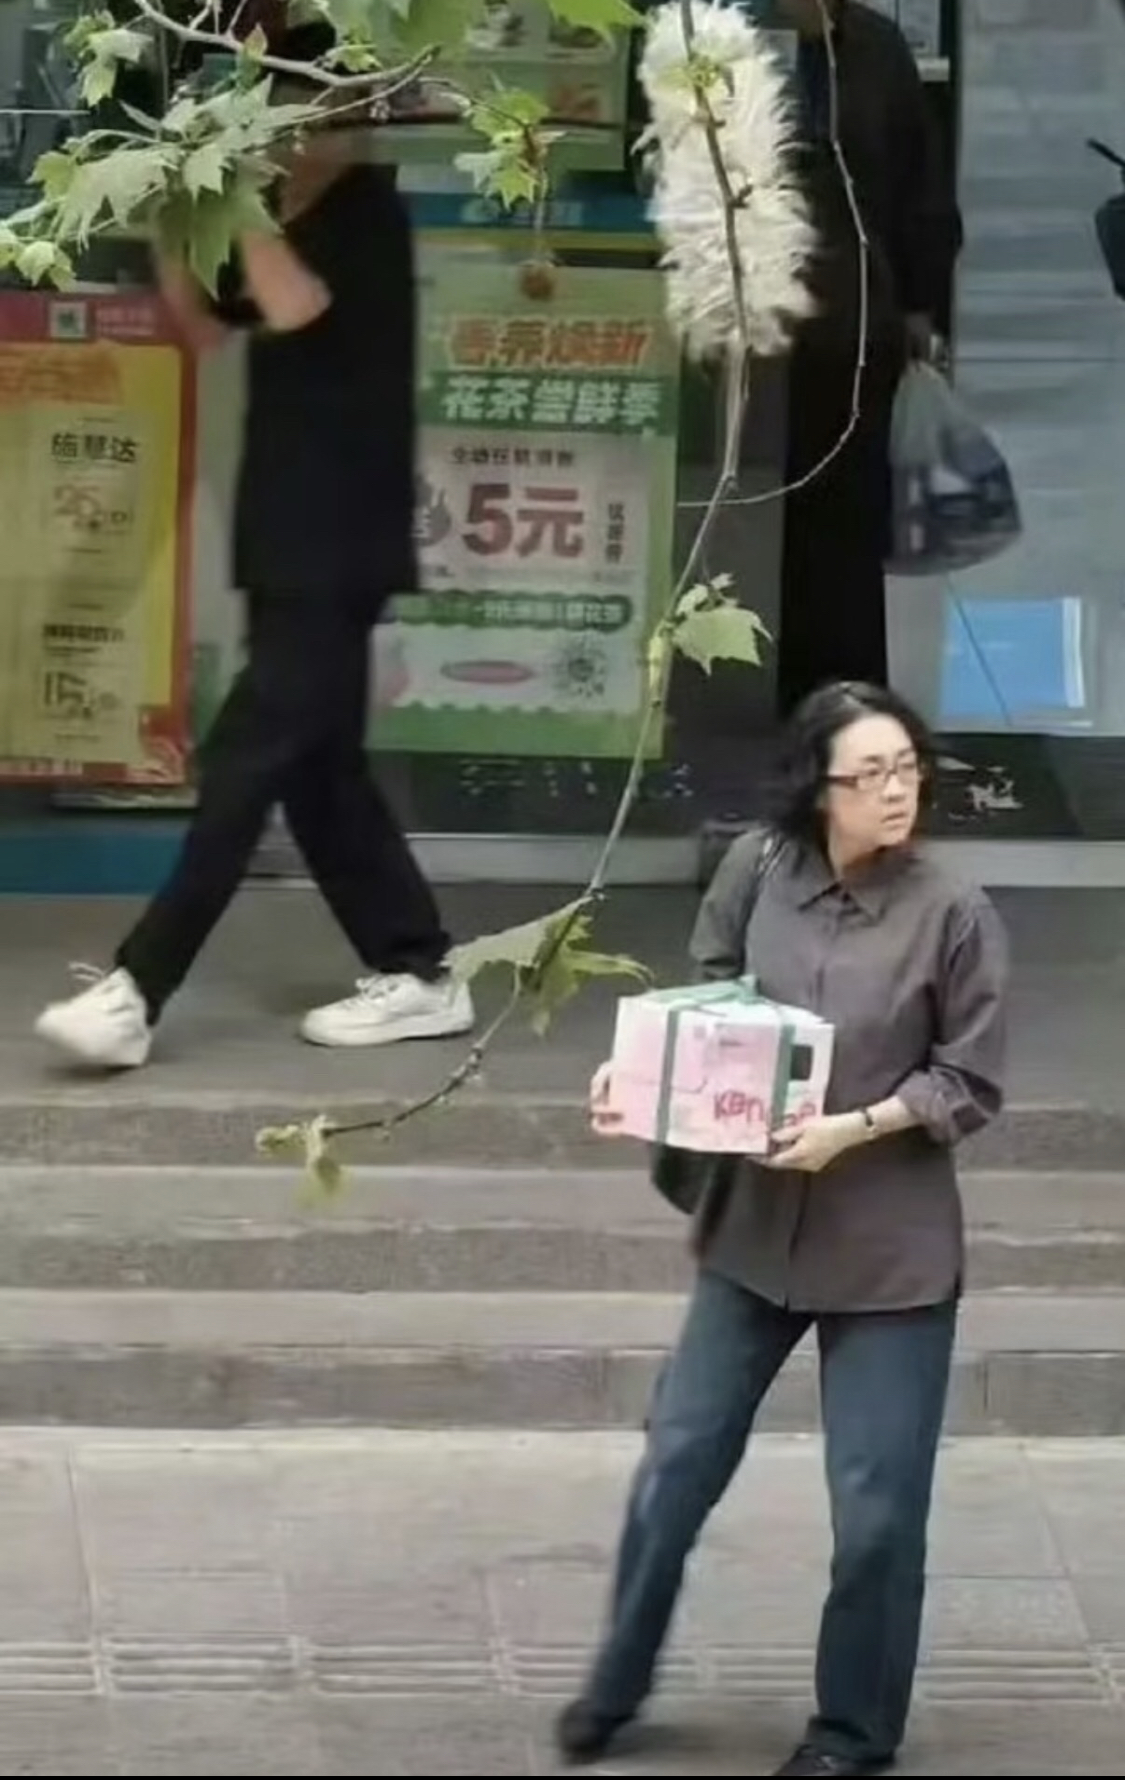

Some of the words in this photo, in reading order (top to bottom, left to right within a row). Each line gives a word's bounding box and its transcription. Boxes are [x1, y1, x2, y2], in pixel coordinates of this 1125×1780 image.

[442, 377, 661, 426] 花茶尝鲜季
[461, 483, 584, 558] 5元
